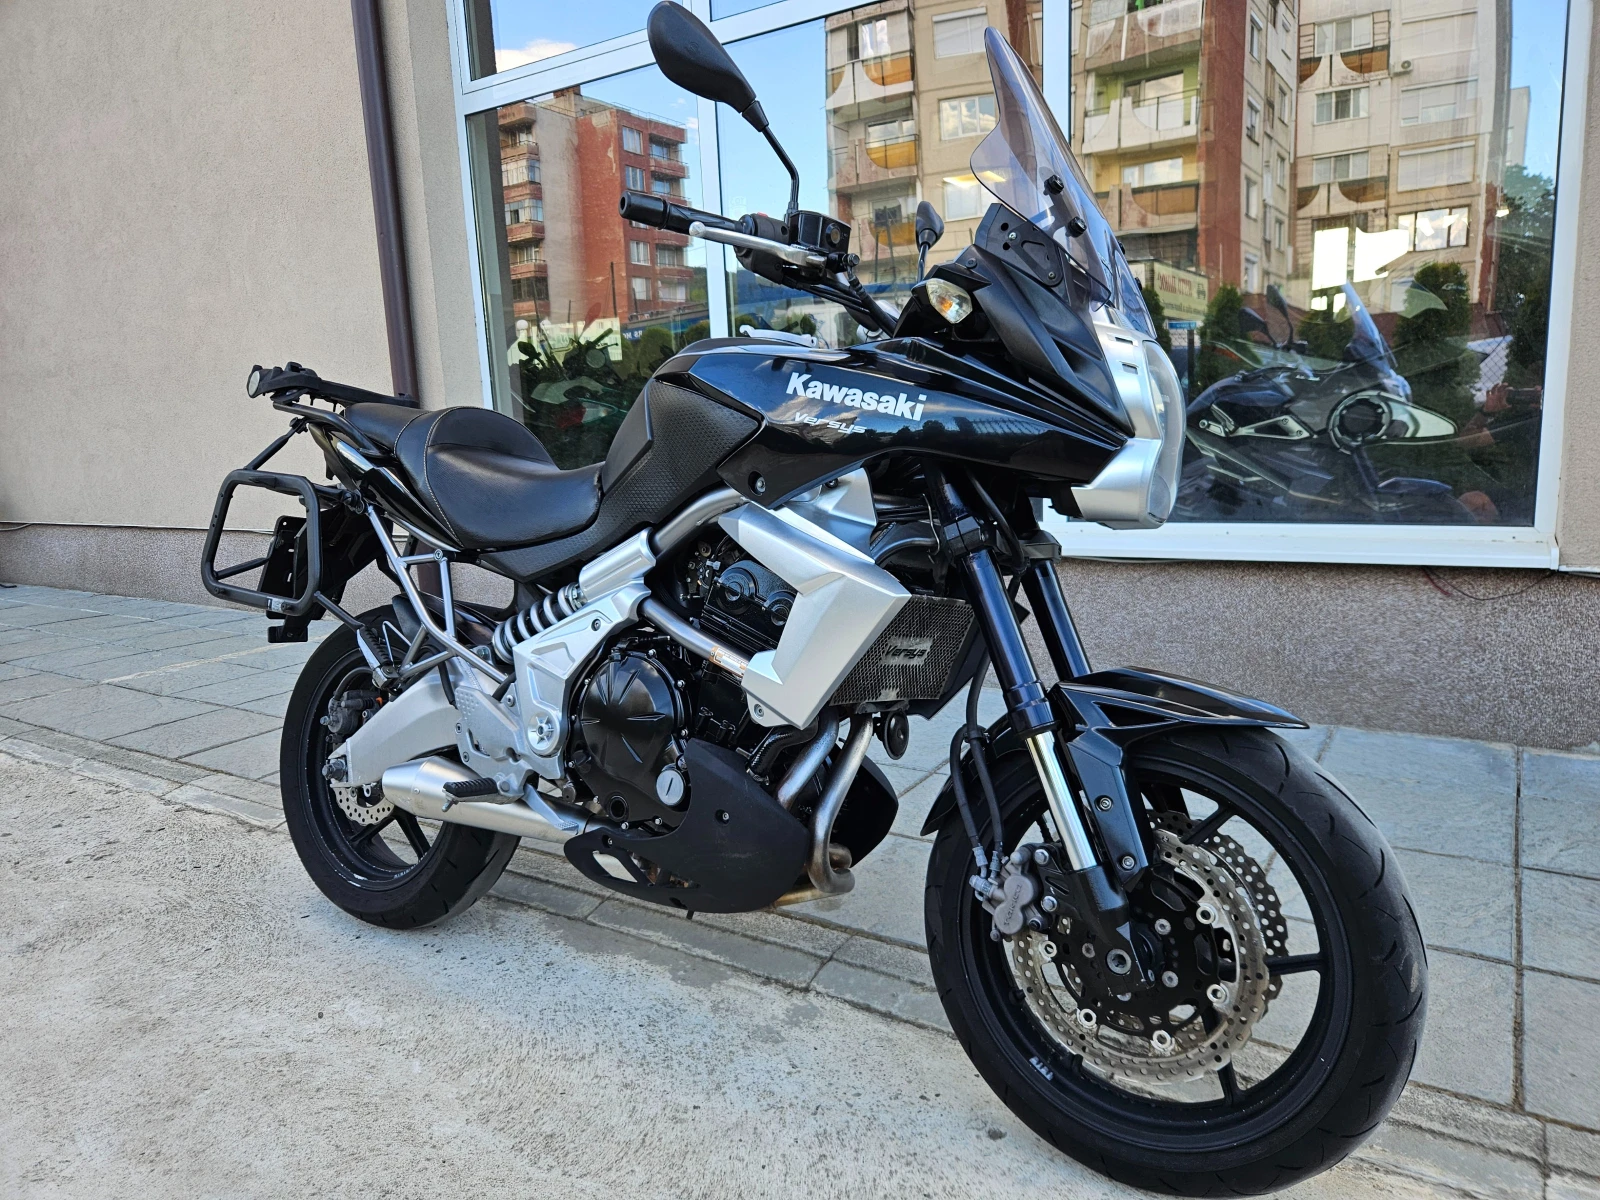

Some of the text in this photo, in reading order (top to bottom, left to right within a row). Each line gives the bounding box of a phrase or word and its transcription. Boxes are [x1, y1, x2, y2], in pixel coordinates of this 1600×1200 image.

[786, 371, 927, 421] Kawasaki
[794, 412, 867, 434] Versys
[885, 645, 927, 659] Versys
